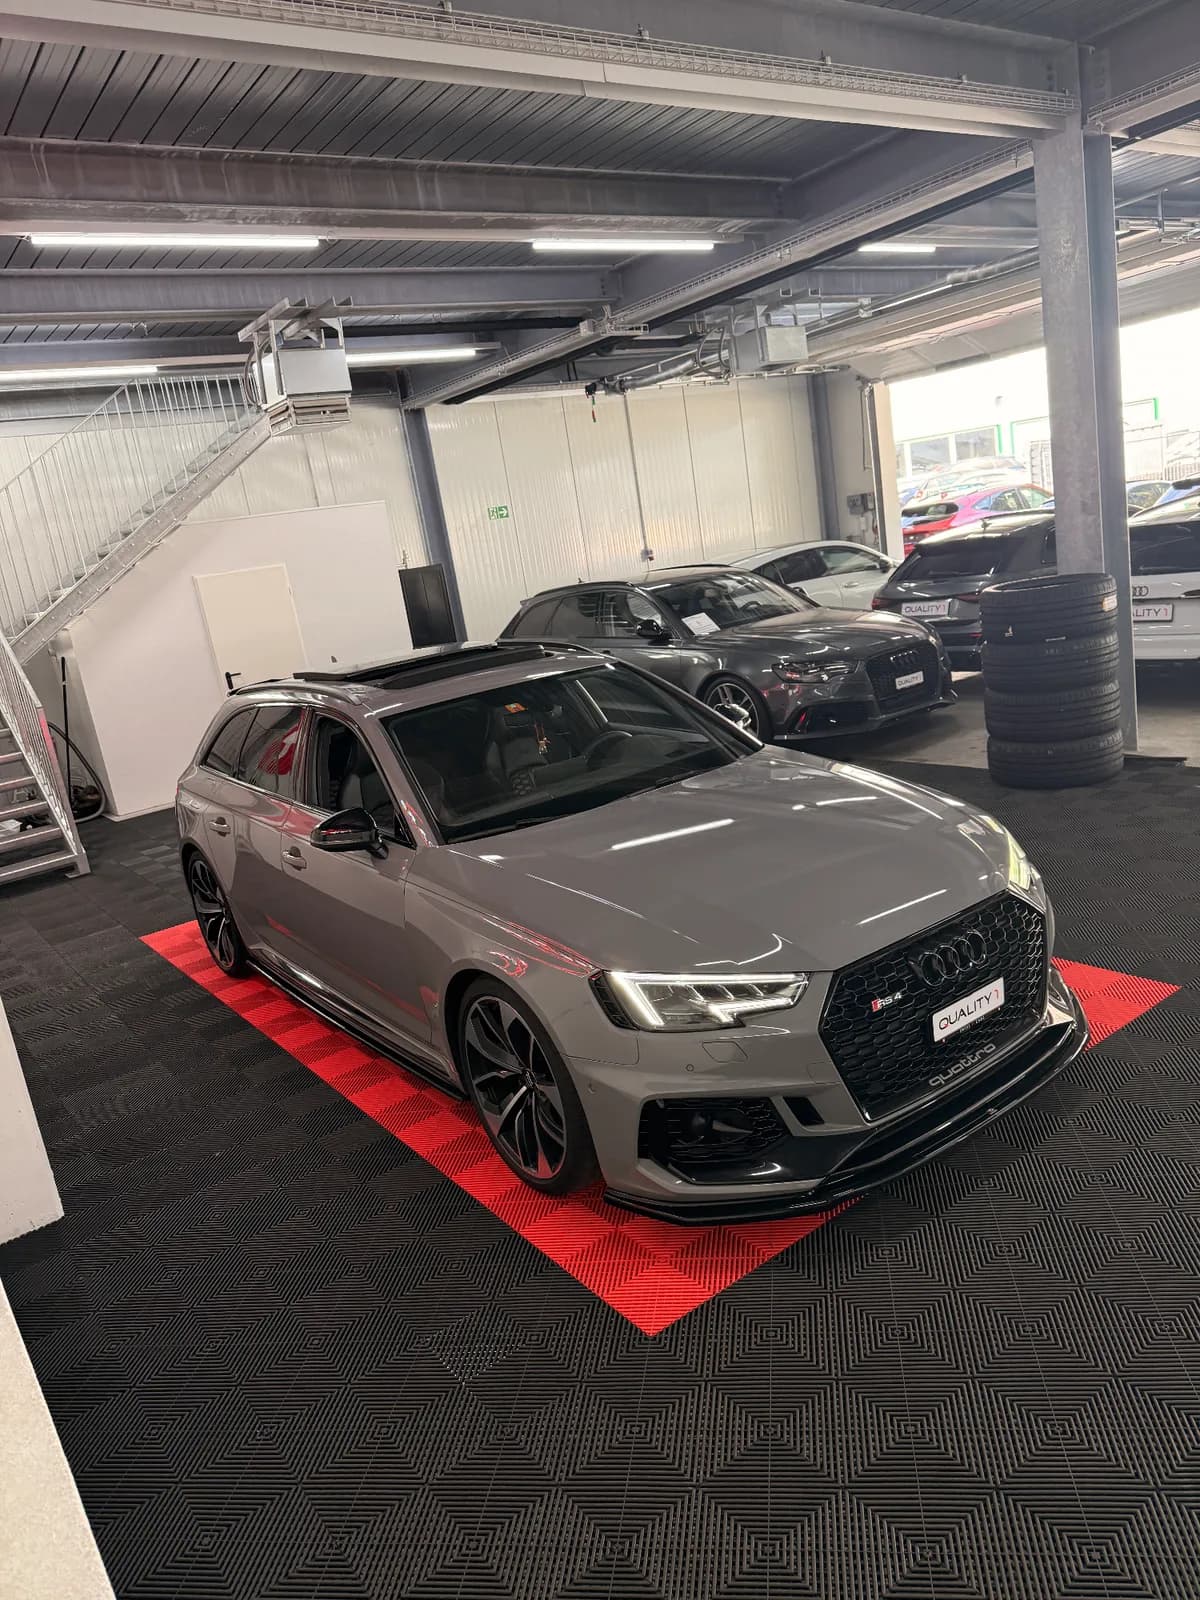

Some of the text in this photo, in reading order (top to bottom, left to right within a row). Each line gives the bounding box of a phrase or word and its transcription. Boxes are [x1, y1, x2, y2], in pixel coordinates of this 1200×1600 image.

[904, 604, 941, 612] QUALITY
[1132, 608, 1168, 616] LITY 1
[938, 992, 992, 1030] QUALITY
[994, 989, 1000, 1000] 1
[929, 1043, 996, 1086] quattro
